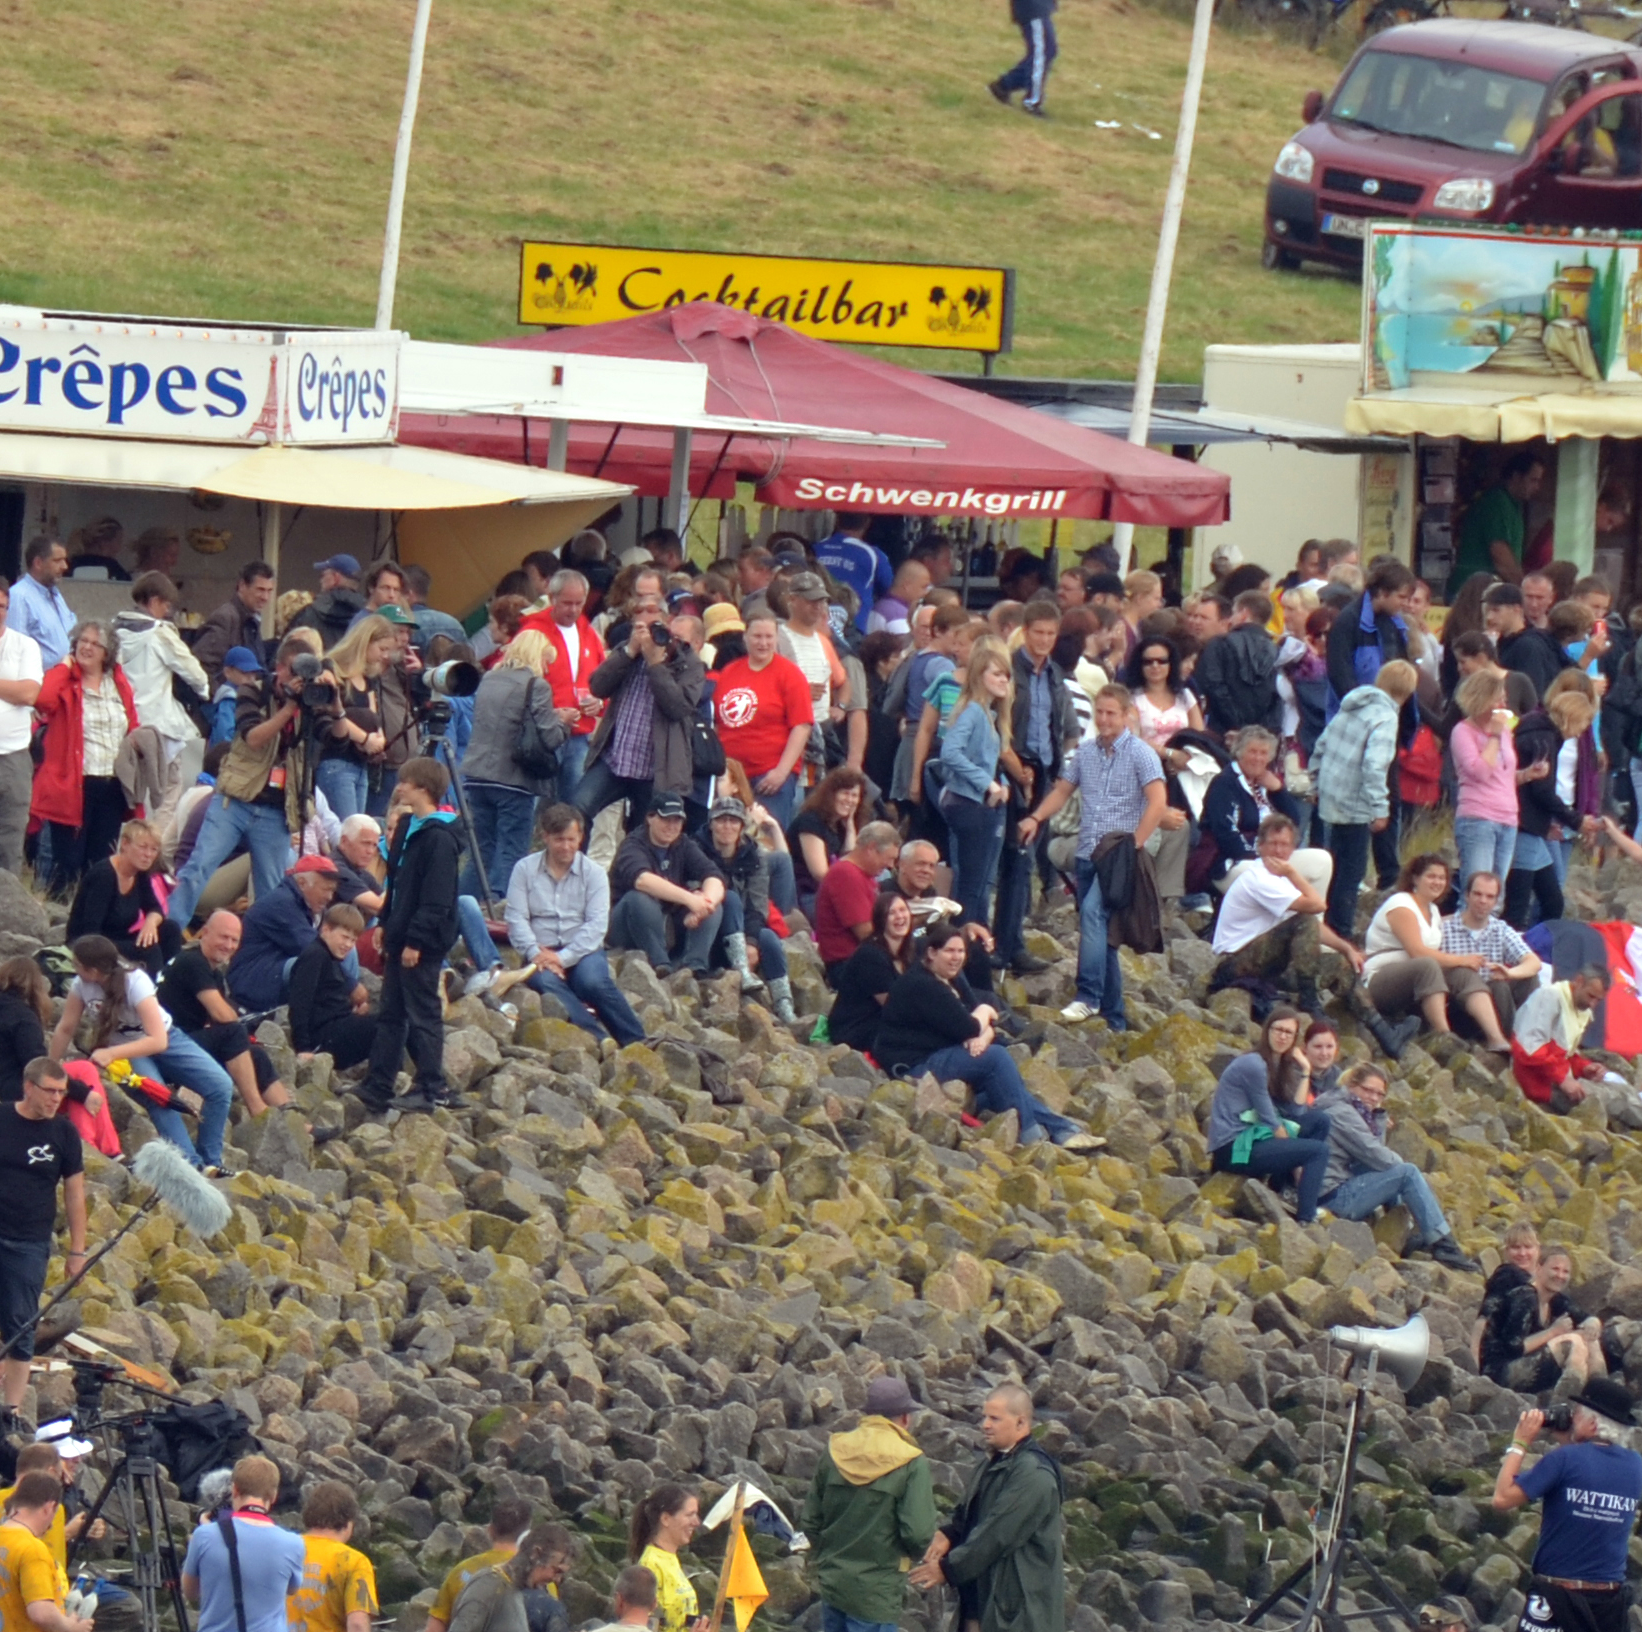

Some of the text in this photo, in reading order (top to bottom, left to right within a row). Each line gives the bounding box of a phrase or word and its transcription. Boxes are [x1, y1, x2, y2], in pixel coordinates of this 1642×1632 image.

[296, 352, 387, 433] Crêpes
[794, 477, 1067, 514] Schwenkgrill
[1566, 1487, 1639, 1512] WATTIKAN
